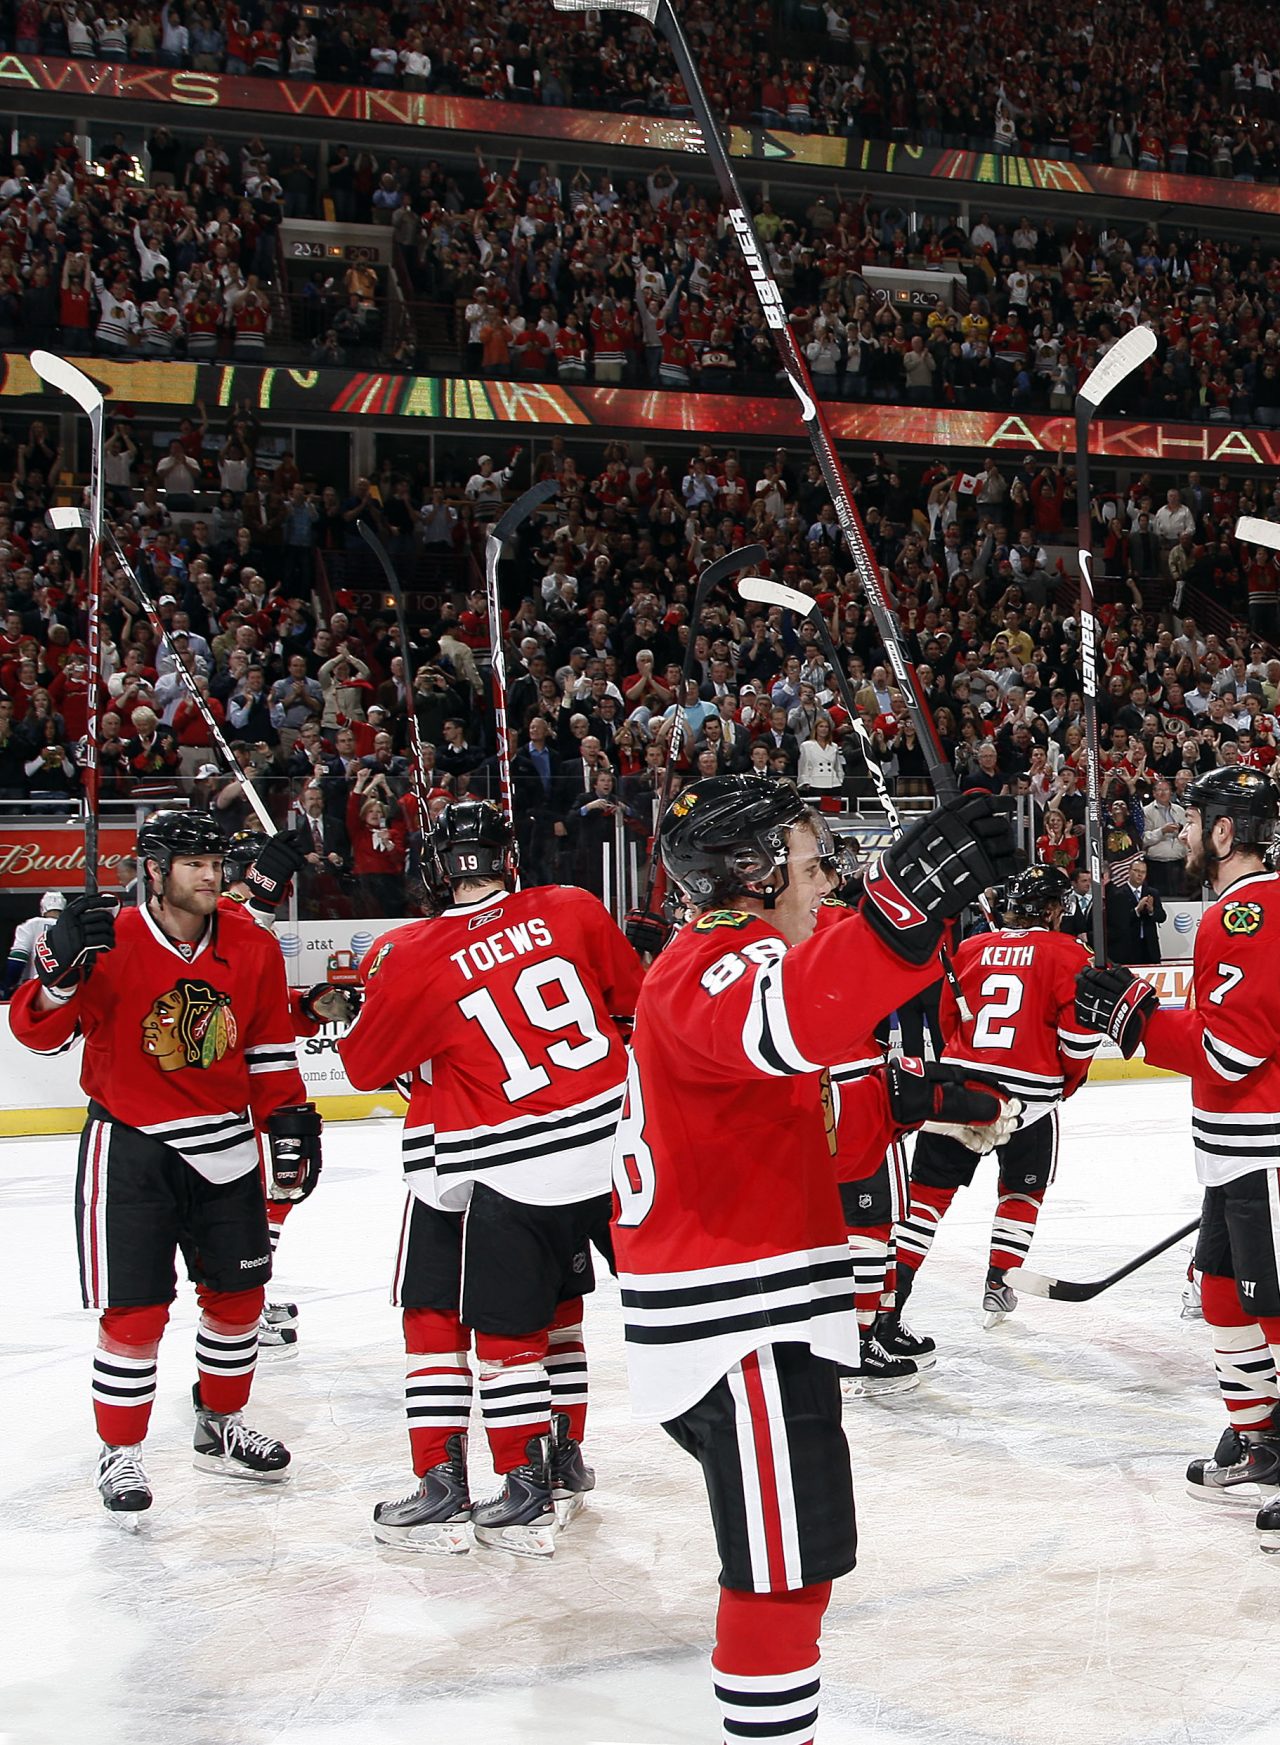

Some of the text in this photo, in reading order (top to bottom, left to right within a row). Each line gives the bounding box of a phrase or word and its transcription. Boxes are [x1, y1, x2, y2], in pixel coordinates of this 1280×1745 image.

[279, 80, 427, 127] WIN!
[729, 208, 785, 330] BAUER
[87, 593, 99, 769] EASTON
[1081, 610, 1096, 698] BAUER
[459, 854, 478, 872] 19
[306, 938, 334, 950] at&t
[449, 917, 554, 981] TOEWS
[700, 938, 790, 997] 88
[980, 945, 1035, 967] KEITH
[972, 973, 1025, 1049] 2
[1209, 963, 1244, 1005] 7
[457, 955, 610, 1102] 19
[303, 1071, 326, 1082] ome
